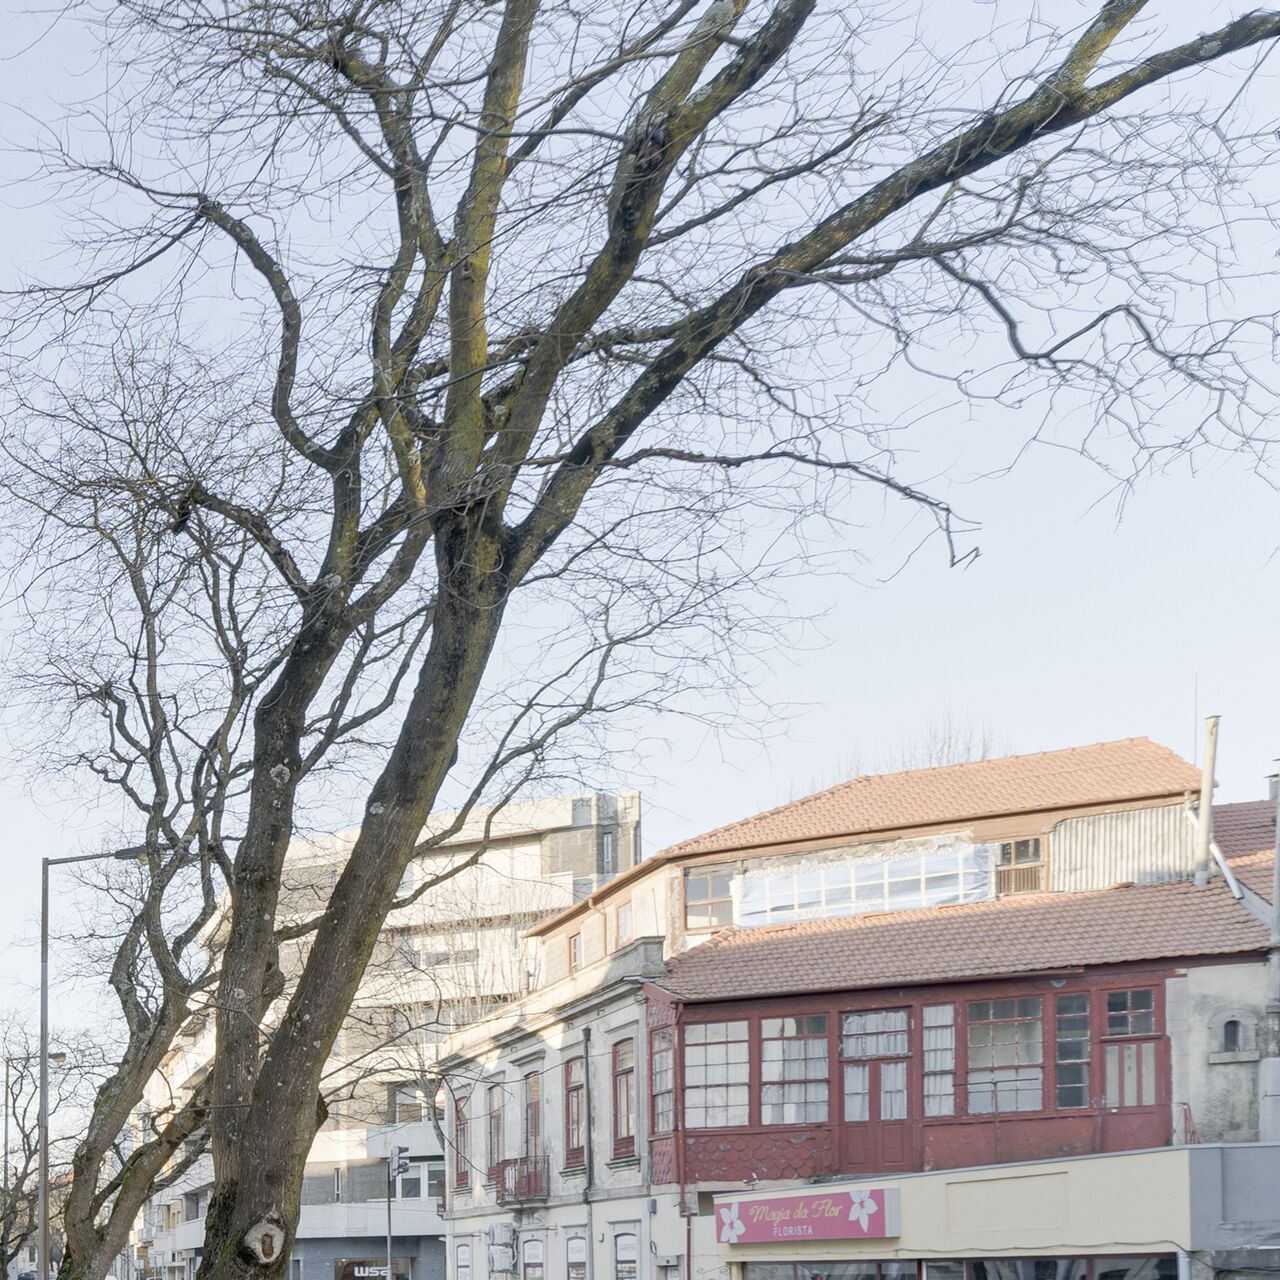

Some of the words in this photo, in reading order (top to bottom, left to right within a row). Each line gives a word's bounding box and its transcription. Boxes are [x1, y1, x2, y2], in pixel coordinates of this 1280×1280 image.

[749, 1205, 791, 1226] Magia
[793, 1201, 808, 1219] da
[811, 1198, 844, 1218] Flor
[773, 1224, 814, 1237] FLORISTA
